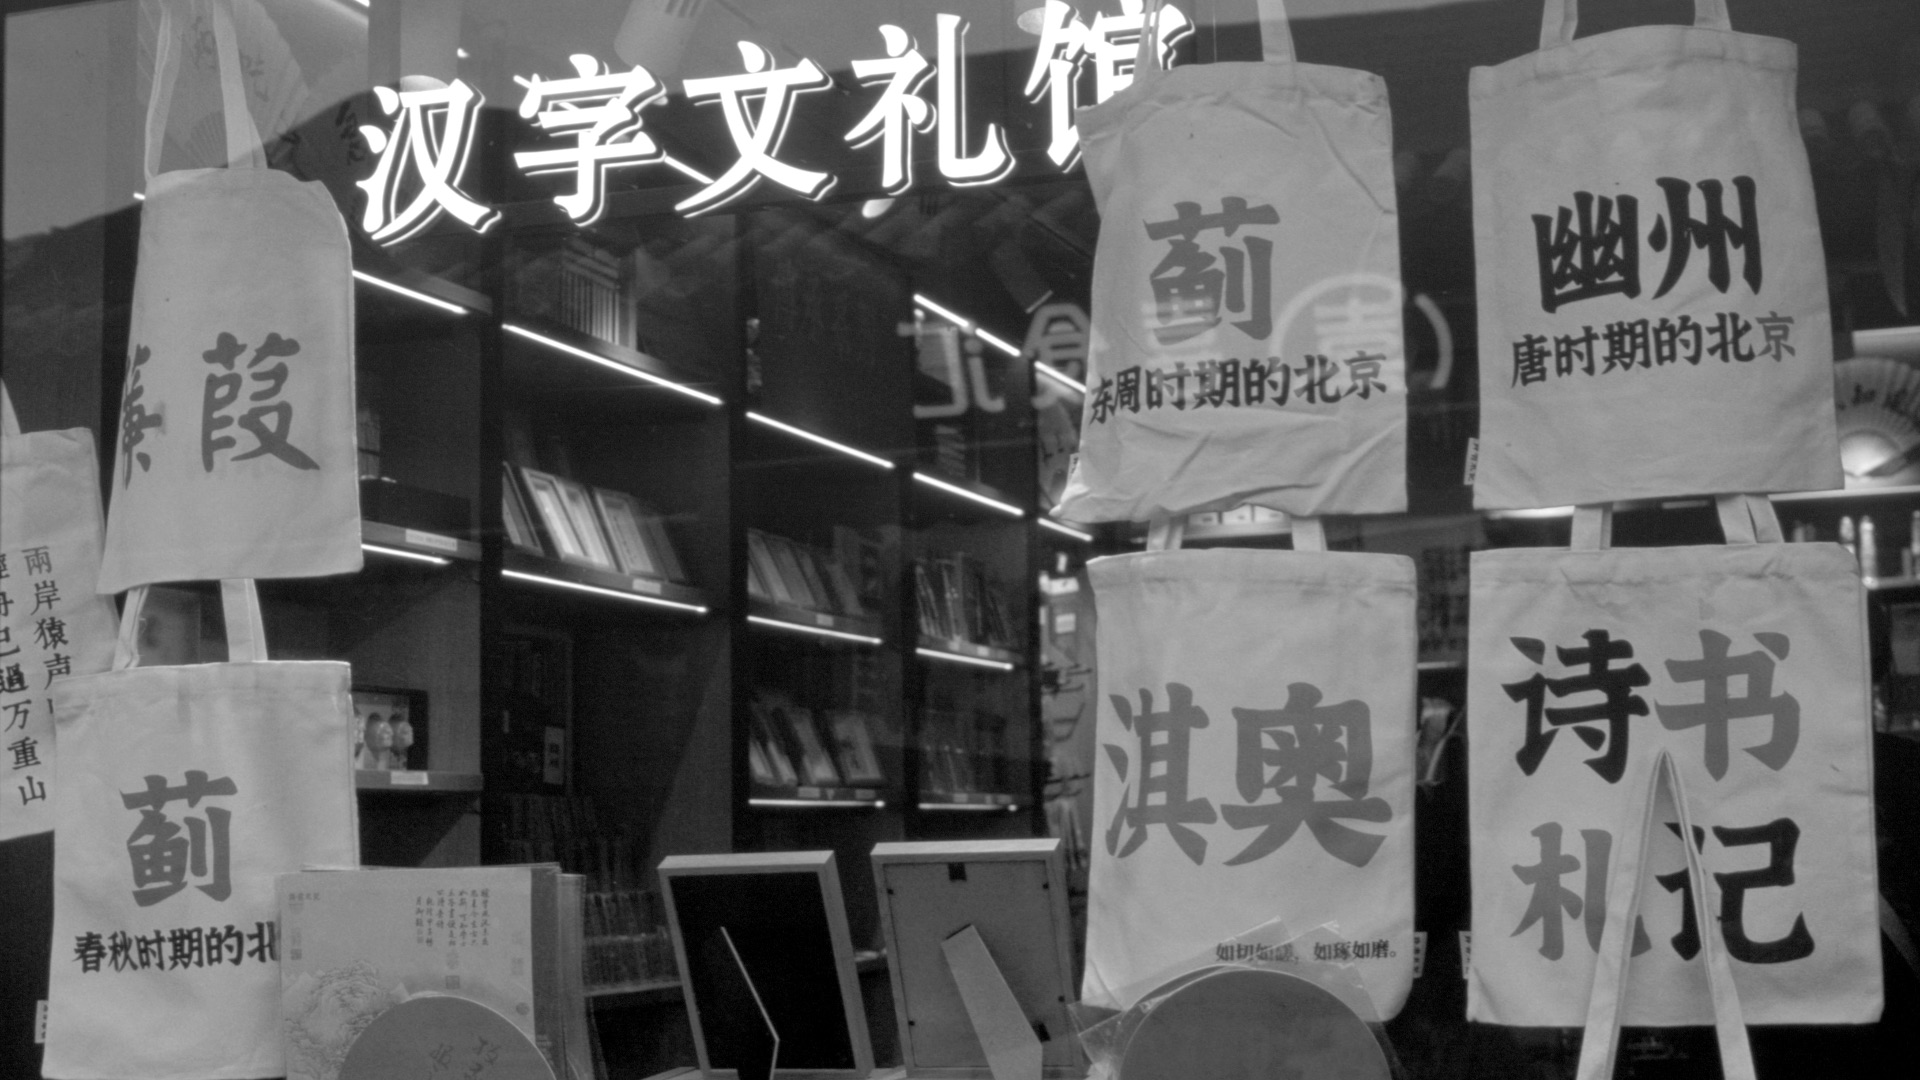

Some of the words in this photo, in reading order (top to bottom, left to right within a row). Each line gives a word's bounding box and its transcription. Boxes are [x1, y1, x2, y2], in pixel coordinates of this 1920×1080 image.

[355, 0, 1196, 247] 汉字文礼馆
[1143, 196, 1280, 345] 蓟
[1531, 175, 1763, 314] 幽州
[1089, 350, 1387, 425] 东周时期的北京
[1511, 311, 1796, 388] 唐时期的北京
[22, 545, 71, 715] 兩岸猿声
[1102, 682, 1393, 868] 淇奥
[1501, 629, 1800, 784] 诗书
[119, 770, 238, 907] 蓟
[1509, 817, 1815, 964] 札记
[72, 921, 281, 974] 春秋时期的北
